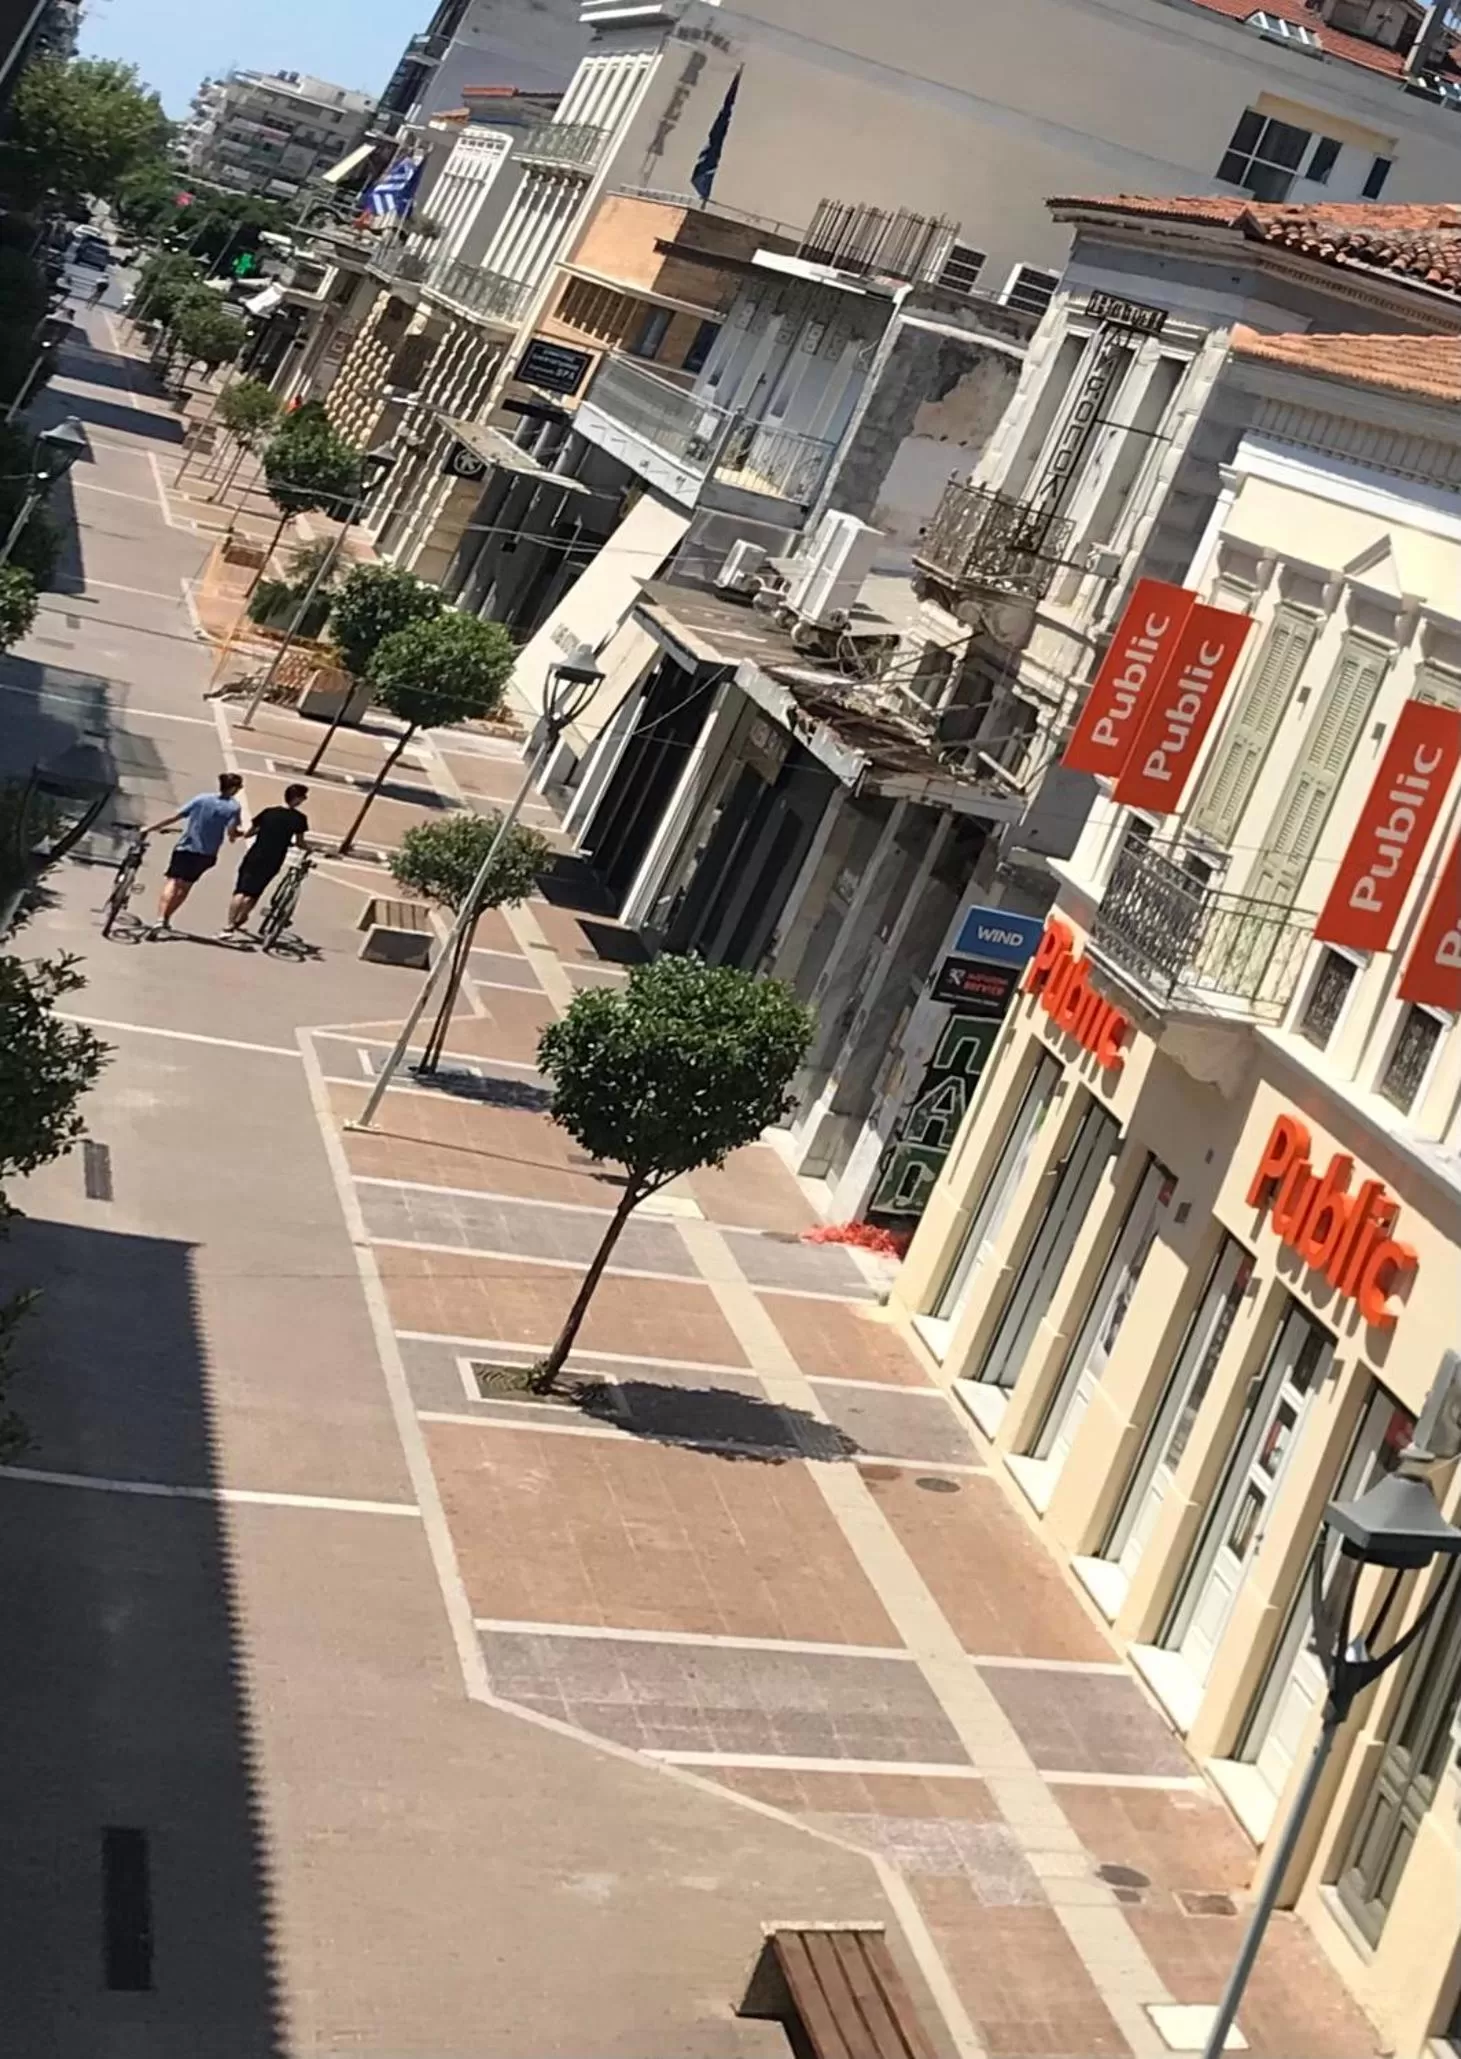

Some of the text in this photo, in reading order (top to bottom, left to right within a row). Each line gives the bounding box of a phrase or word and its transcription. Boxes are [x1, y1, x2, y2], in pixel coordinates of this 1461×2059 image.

[646, 51, 708, 157] REX
[1091, 612, 1170, 748] Public
[1142, 640, 1225, 782] Public
[1349, 743, 1443, 913] Public
[977, 925, 1024, 947] WIND
[1024, 919, 1127, 1073] Public
[1245, 1113, 1420, 1332] Public
